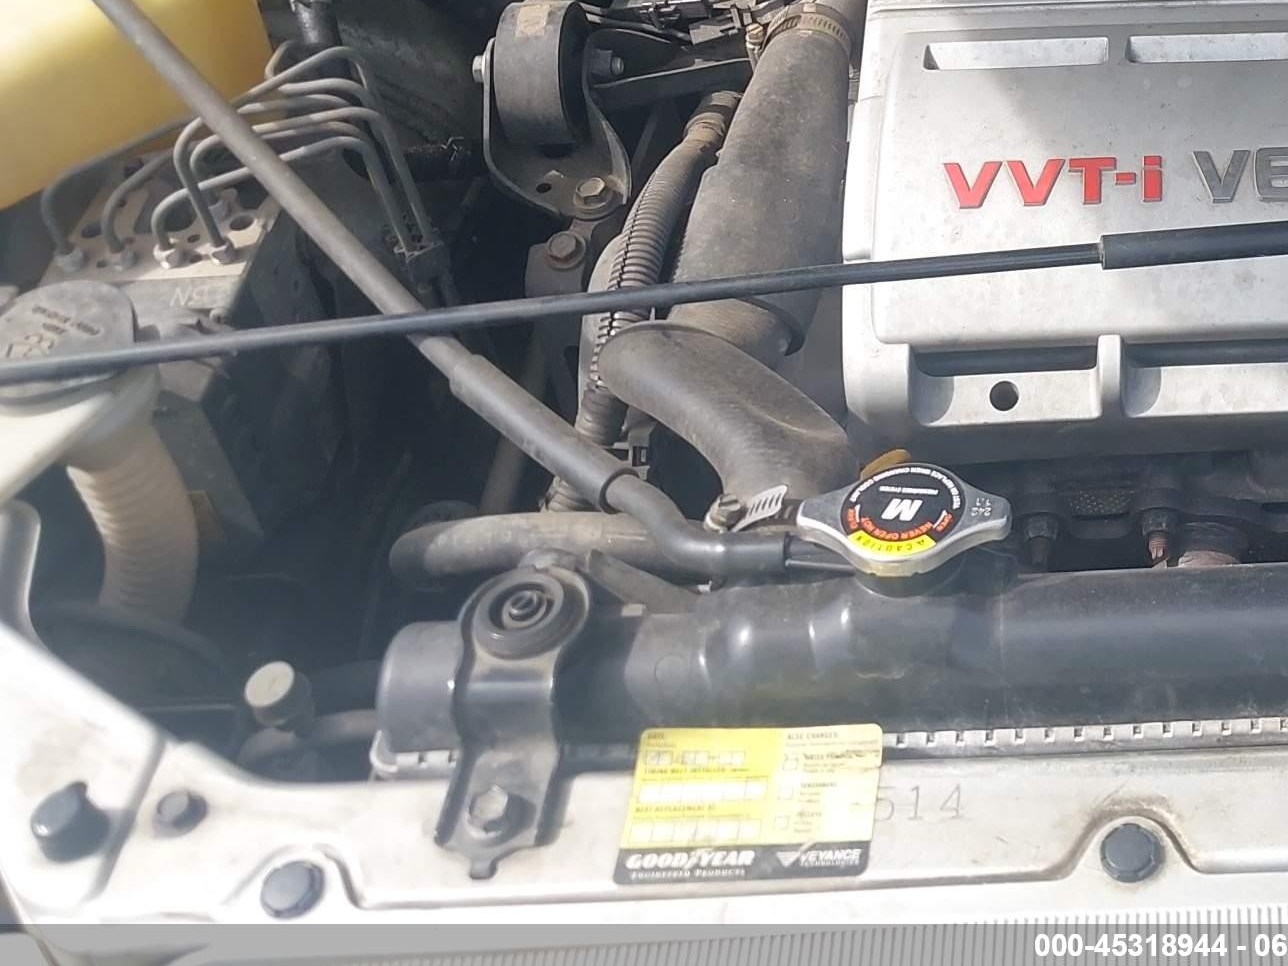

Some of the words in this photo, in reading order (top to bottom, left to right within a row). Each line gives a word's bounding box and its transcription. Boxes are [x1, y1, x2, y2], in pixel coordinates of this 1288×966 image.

[943, 154, 1163, 210] VVT-i
[881, 498, 924, 521] M
[971, 506, 993, 517] 242
[624, 849, 755, 869] GOODYEAR
